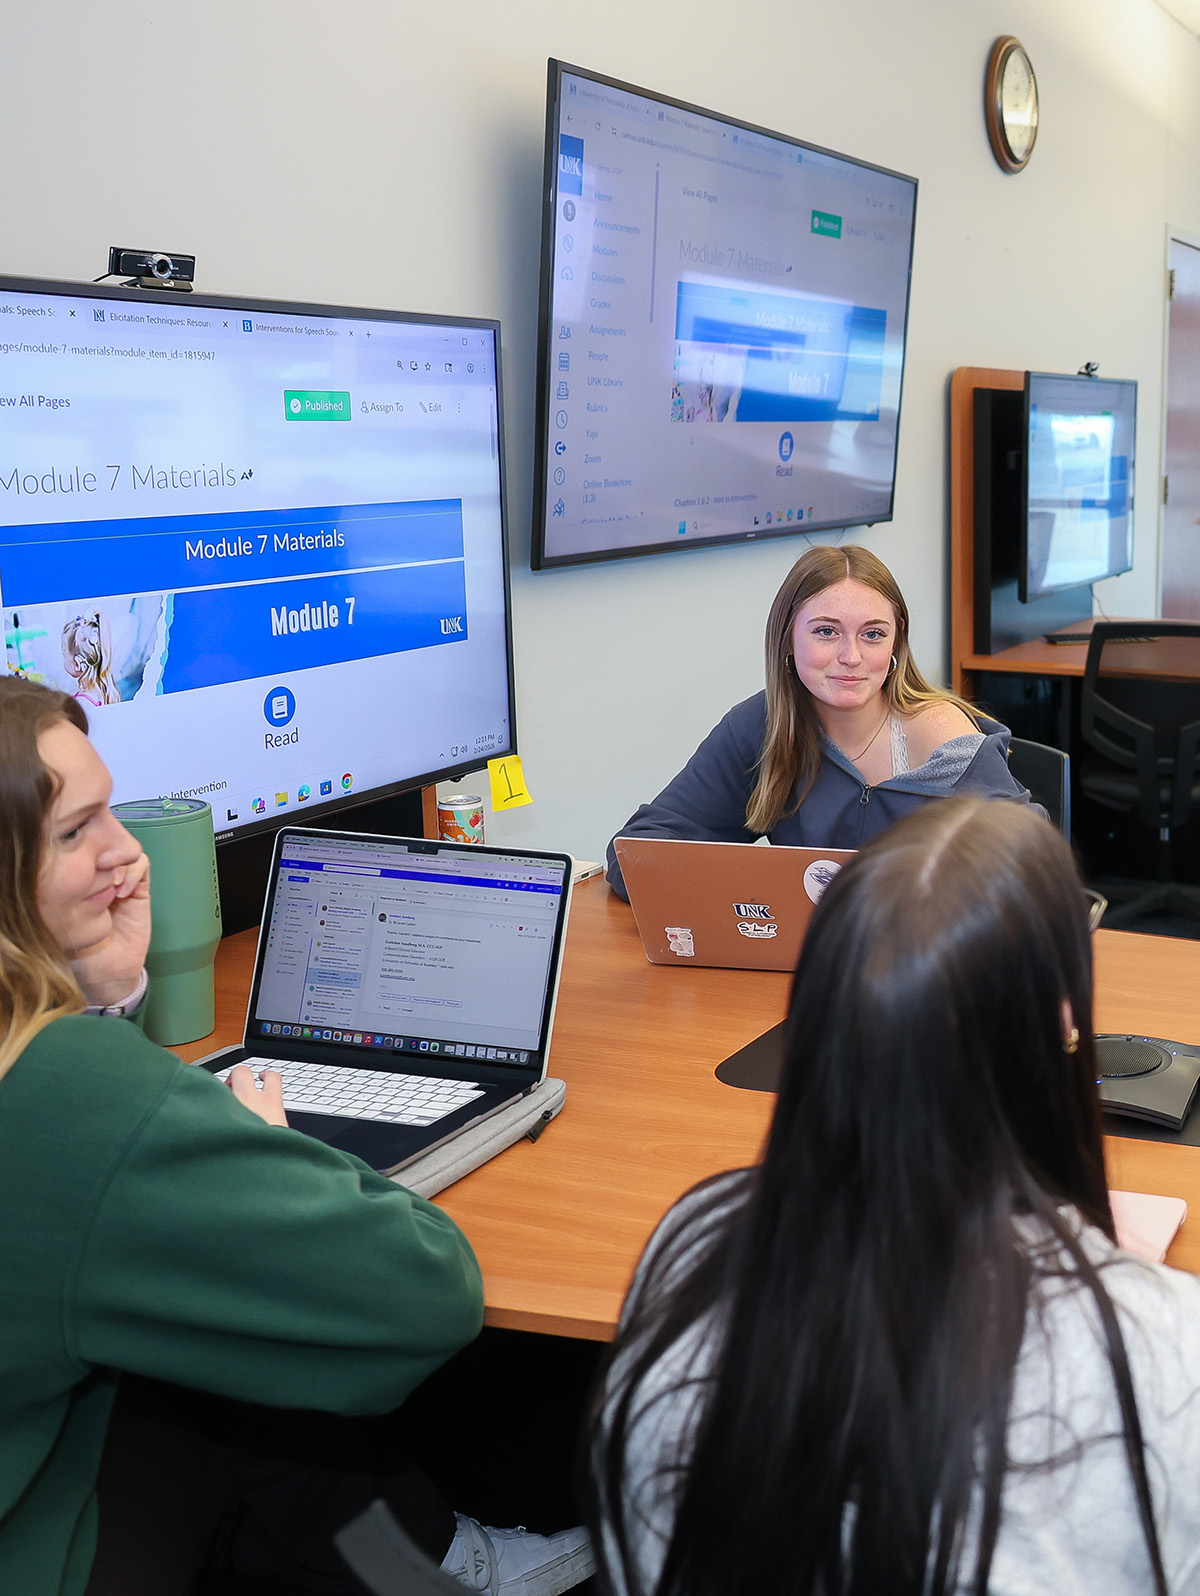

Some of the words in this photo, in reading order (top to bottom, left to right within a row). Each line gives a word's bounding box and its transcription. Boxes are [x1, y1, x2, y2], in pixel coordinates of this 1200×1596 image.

[560, 154, 582, 176] UNK
[595, 190, 613, 203] Home
[594, 218, 640, 235] Announcements
[680, 240, 723, 266] Module
[728, 248, 735, 267] 7
[16, 305, 46, 317] Speech
[110, 312, 144, 323] Elicitation
[146, 314, 185, 327] Techniques:
[256, 323, 294, 334] Interventions
[295, 325, 303, 334] for
[304, 326, 324, 336] Speech
[589, 324, 626, 337] Assignments
[0, 341, 215, 361] ges/module-7-materials?module_item_id=1815947
[588, 351, 608, 361] People
[587, 376, 602, 386] UNK
[603, 377, 623, 388] Library
[788, 370, 820, 394] Module
[823, 372, 830, 394] 7
[19, 395, 35, 407] All
[38, 395, 71, 410] Pages
[305, 400, 344, 411] Published
[370, 402, 392, 413] Assign
[393, 402, 404, 412] To
[428, 402, 442, 412] Edit
[586, 402, 608, 413] Rubrics
[584, 454, 601, 464] Zoom
[776, 465, 793, 477] Read
[0, 465, 97, 495] Module
[105, 465, 121, 491] 7
[132, 462, 237, 490] Materials
[583, 479, 602, 489] Online
[603, 478, 632, 488] Bookstore
[185, 536, 253, 561] Module
[258, 535, 268, 555] 7
[273, 530, 345, 552] Materials
[270, 601, 339, 636] Module
[345, 597, 355, 626] 7
[440, 616, 463, 635] UNK
[264, 728, 300, 750] Read
[499, 763, 524, 801] 1
[171, 780, 228, 799] Intervention
[215, 832, 234, 841] AMSUNG
[734, 904, 772, 918] UNK
